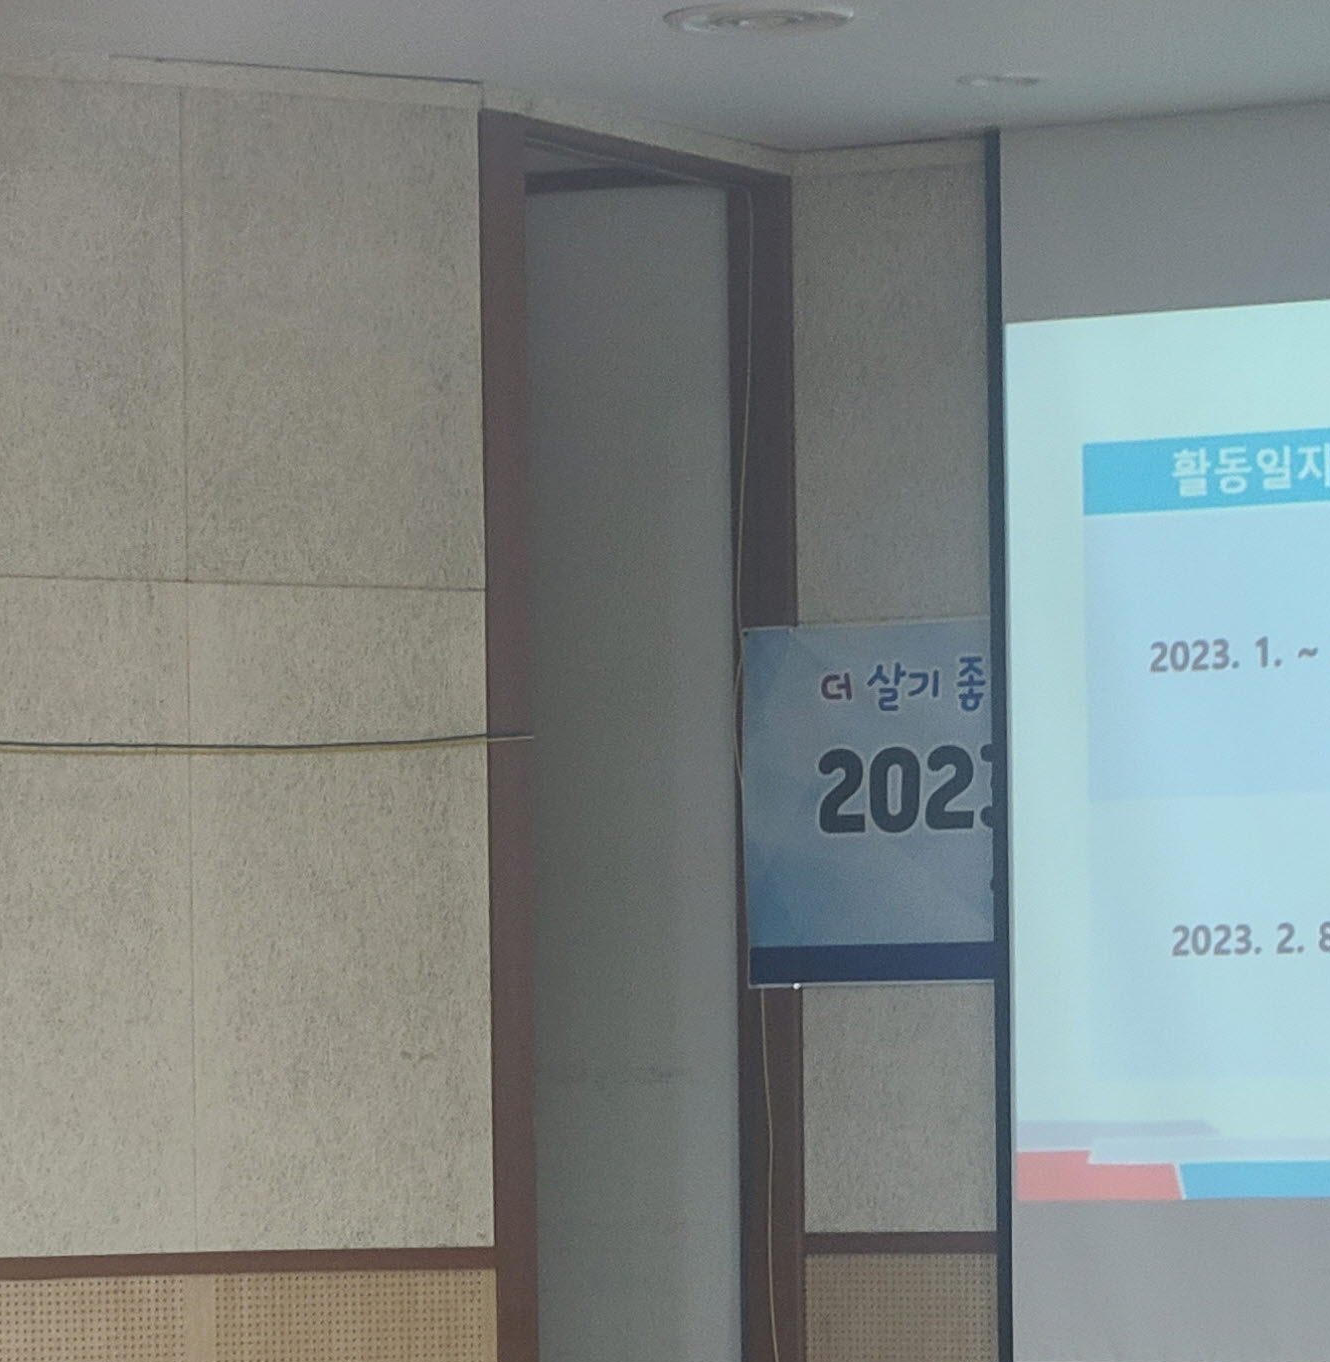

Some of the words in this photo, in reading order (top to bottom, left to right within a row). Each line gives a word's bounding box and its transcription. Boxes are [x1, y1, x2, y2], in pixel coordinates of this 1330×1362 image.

[1149, 638, 1241, 674] 2023.
[1254, 636, 1283, 669] 1.
[820, 672, 853, 701] 더
[867, 662, 940, 712] 살기
[1171, 924, 1264, 958] 2023.
[1275, 922, 1306, 956] 2.
